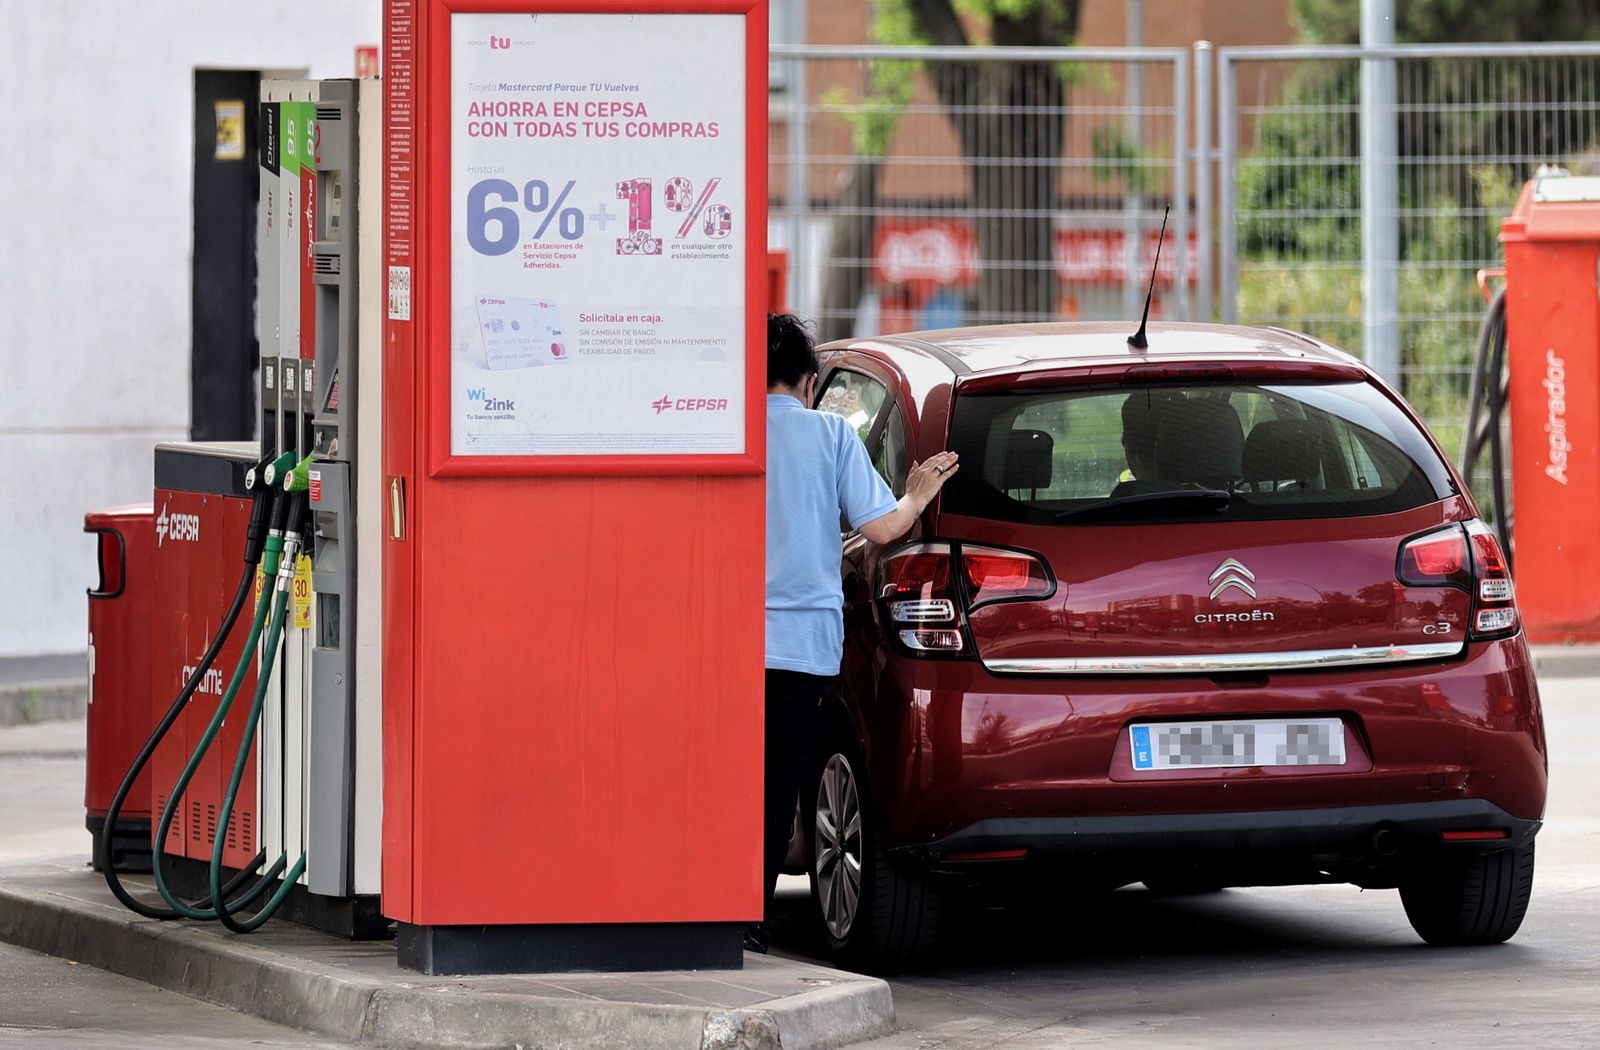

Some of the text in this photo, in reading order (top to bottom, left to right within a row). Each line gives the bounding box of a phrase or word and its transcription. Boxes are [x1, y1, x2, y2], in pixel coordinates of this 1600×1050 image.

[490, 35, 511, 49] tu
[468, 82, 640, 93] Tarjeta Mastercard Porque TU Vuelves
[468, 102, 648, 117] AHORRA EN CEPSA
[468, 122, 720, 138] CON TODAS TUS COMPRAS
[287, 119, 295, 156] 95
[307, 118, 314, 156] 95
[467, 165, 492, 174] Hasta
[467, 178, 585, 256] 6%
[681, 243, 715, 251] cualquier
[523, 252, 577, 261] Servicio Cepsa
[671, 252, 731, 260] establecimiento.
[579, 313, 664, 324] Solicítala en caja.
[579, 338, 727, 346] SIN COMISIÓN DE EMISIÓN NI MANTENIMIENTO
[467, 388, 486, 400] Wi
[484, 398, 515, 411] Zink
[675, 399, 727, 411] CEPSA
[1541, 348, 1568, 485] Aspirador
[169, 513, 199, 541] CEPSA
[295, 579, 307, 597] 30
[1423, 622, 1451, 636] C3
[1139, 751, 1148, 762] E
